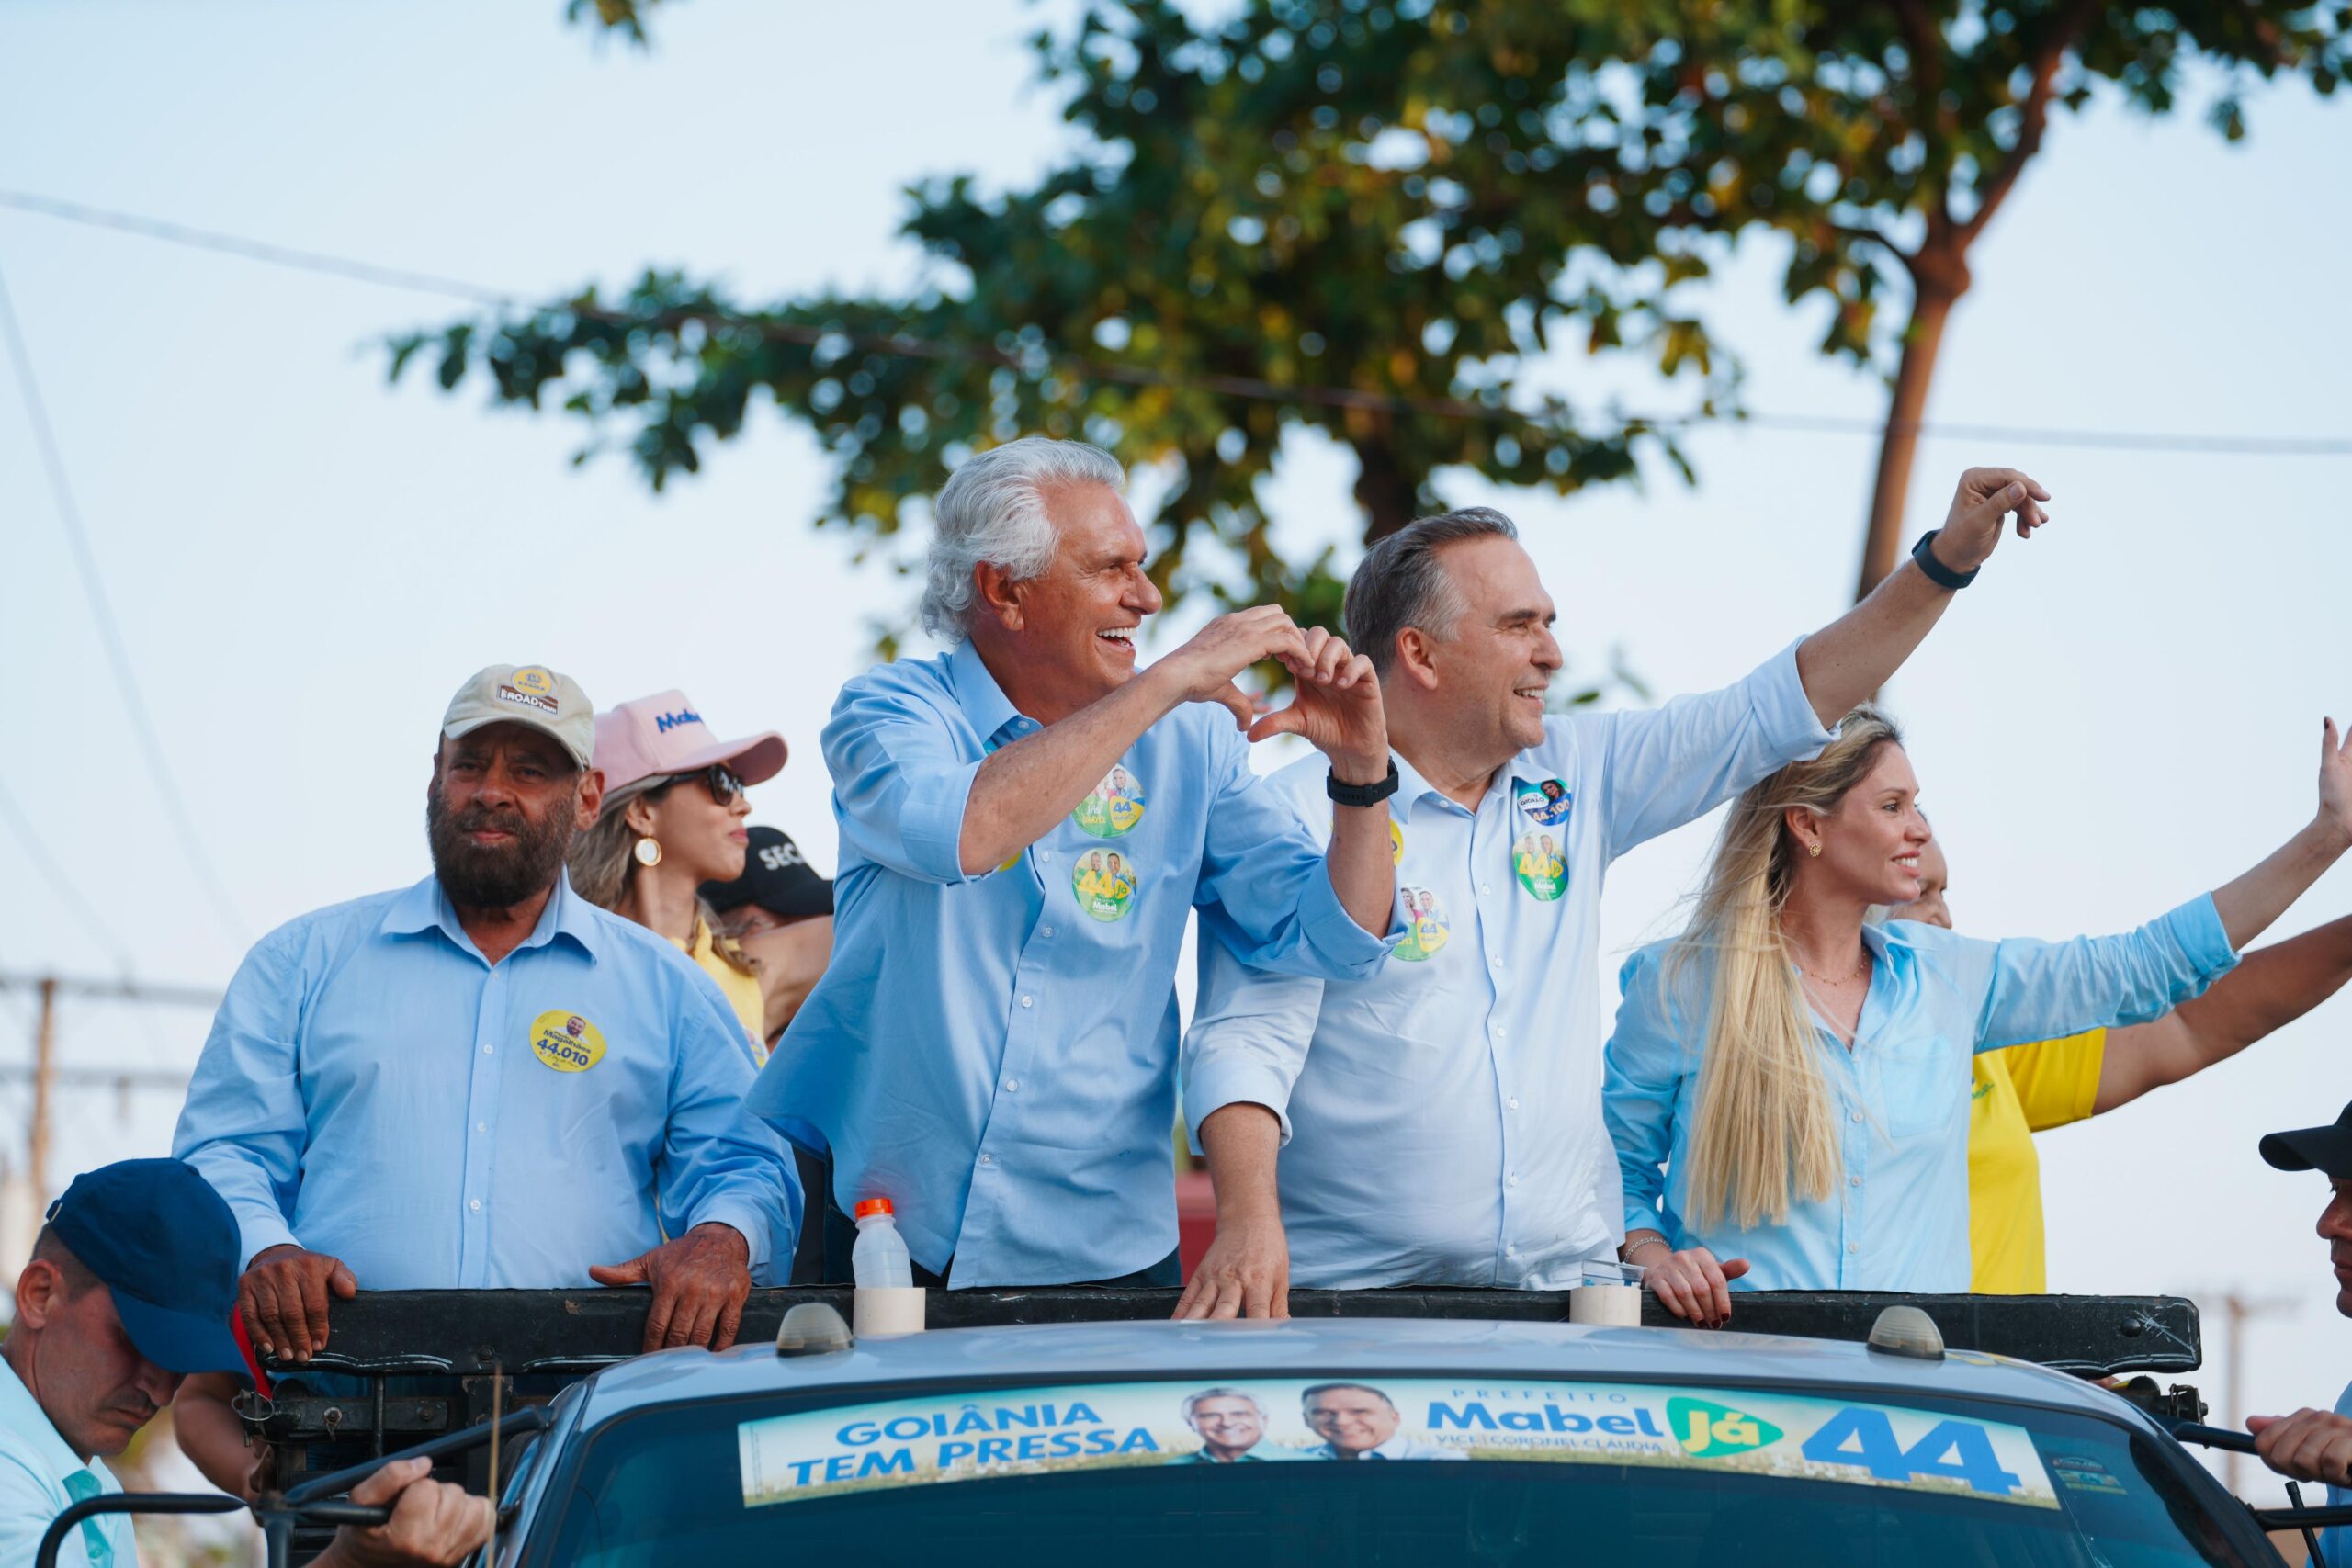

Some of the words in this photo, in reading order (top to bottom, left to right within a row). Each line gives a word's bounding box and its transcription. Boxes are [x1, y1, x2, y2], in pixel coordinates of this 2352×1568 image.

[1113, 801, 1132, 813] 44
[1519, 852, 1551, 878] 44
[1078, 869, 1114, 898] 44
[1420, 922, 1439, 933] 44
[537, 1038, 589, 1066] 44.010
[1452, 1389, 1627, 1403] PREFEITO
[836, 1402, 1103, 1447] GOIÂNIA
[1427, 1402, 1665, 1438] Mabel
[1680, 1410, 1760, 1453] Já
[787, 1448, 916, 1487] TEM
[937, 1427, 1159, 1468] PRESSA
[1801, 1406, 2023, 1495] 44
